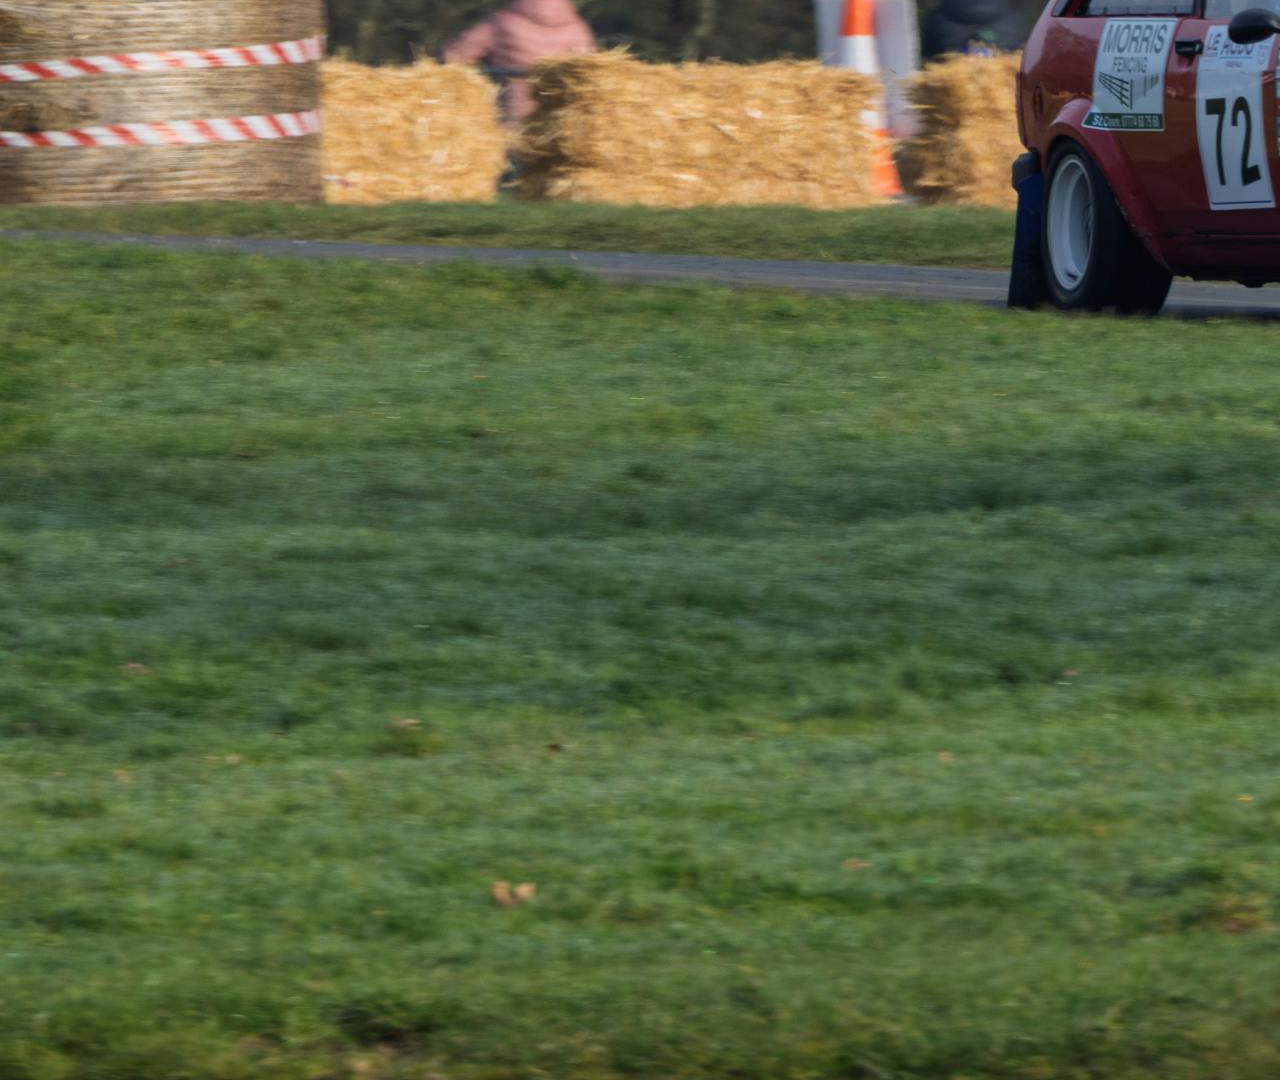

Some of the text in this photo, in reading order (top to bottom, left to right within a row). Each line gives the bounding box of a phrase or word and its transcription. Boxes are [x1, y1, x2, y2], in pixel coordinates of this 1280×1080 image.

[1103, 24, 1167, 54] MORRIS
[1111, 57, 1148, 72] FENCING
[1205, 96, 1262, 186] 72
